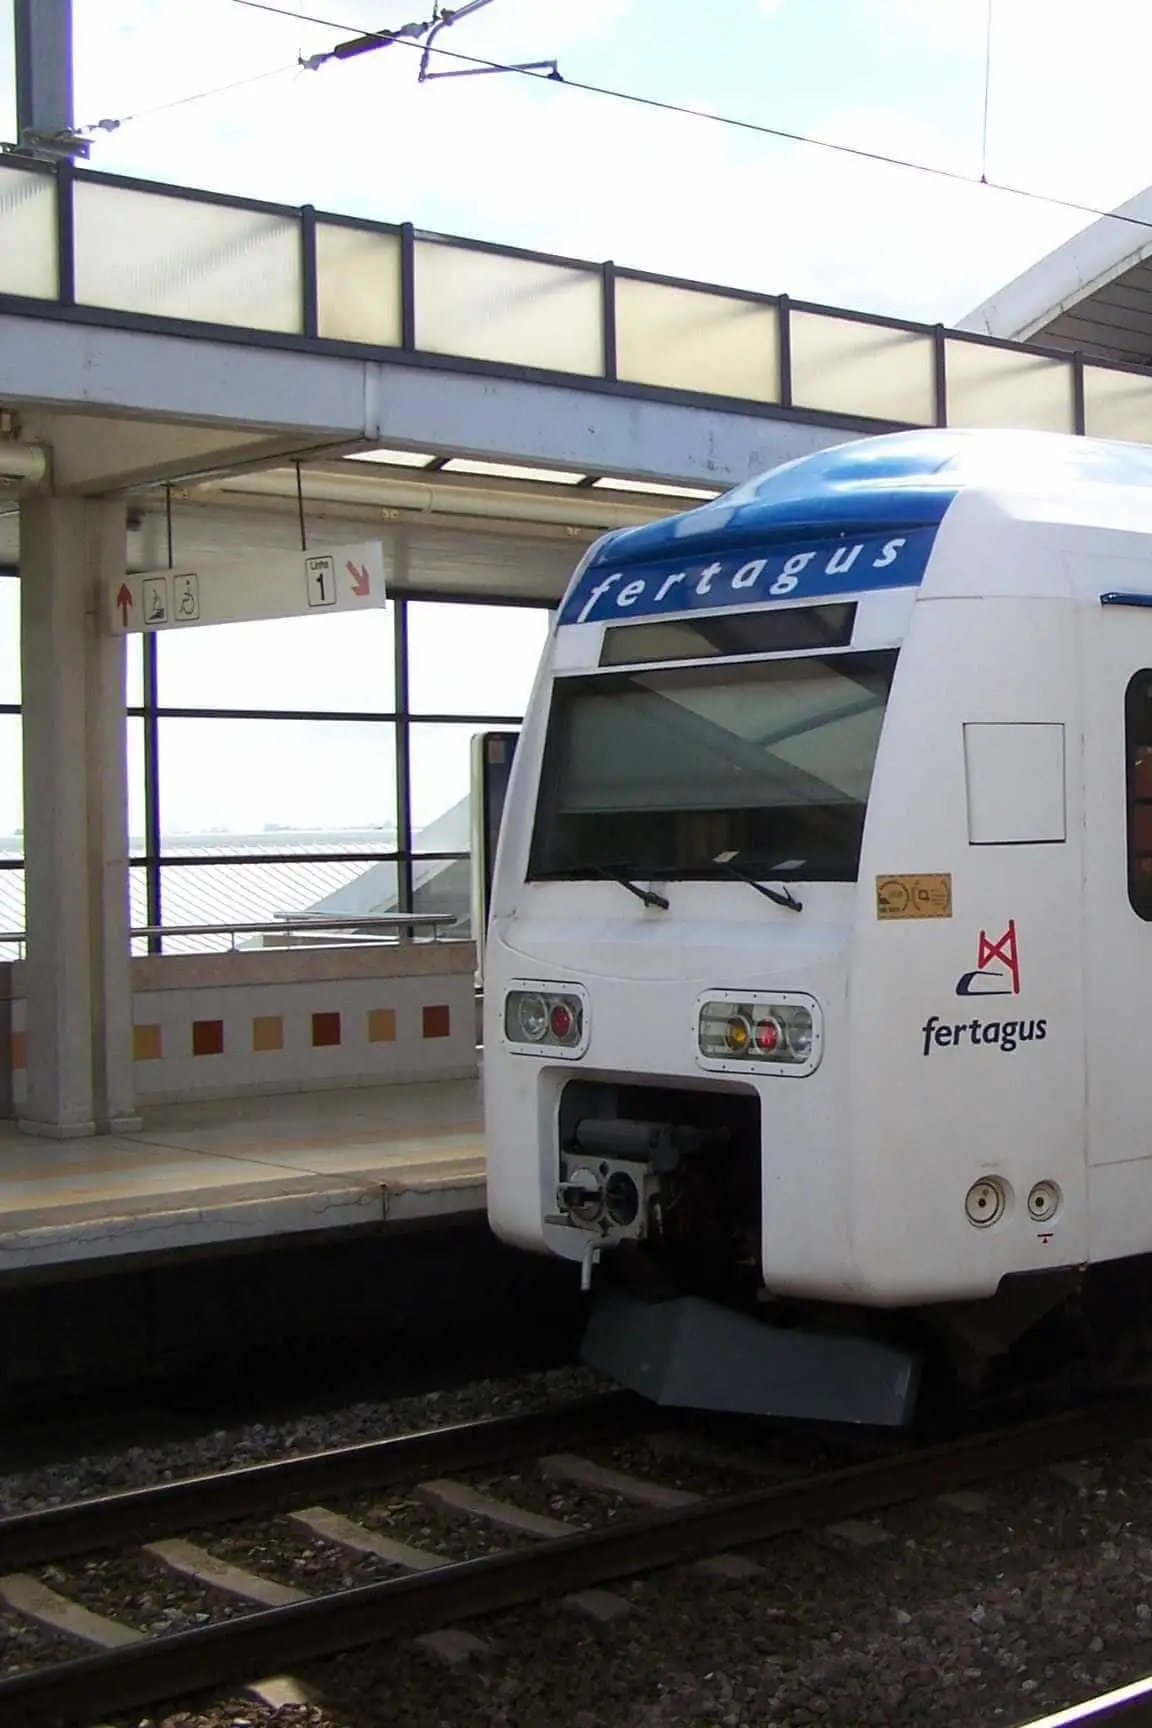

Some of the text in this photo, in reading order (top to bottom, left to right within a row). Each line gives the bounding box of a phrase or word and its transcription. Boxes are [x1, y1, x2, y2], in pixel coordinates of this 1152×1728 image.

[316, 573, 325, 601] 1
[578, 538, 905, 622] fertagus
[922, 1016, 1047, 1056] fertagus
